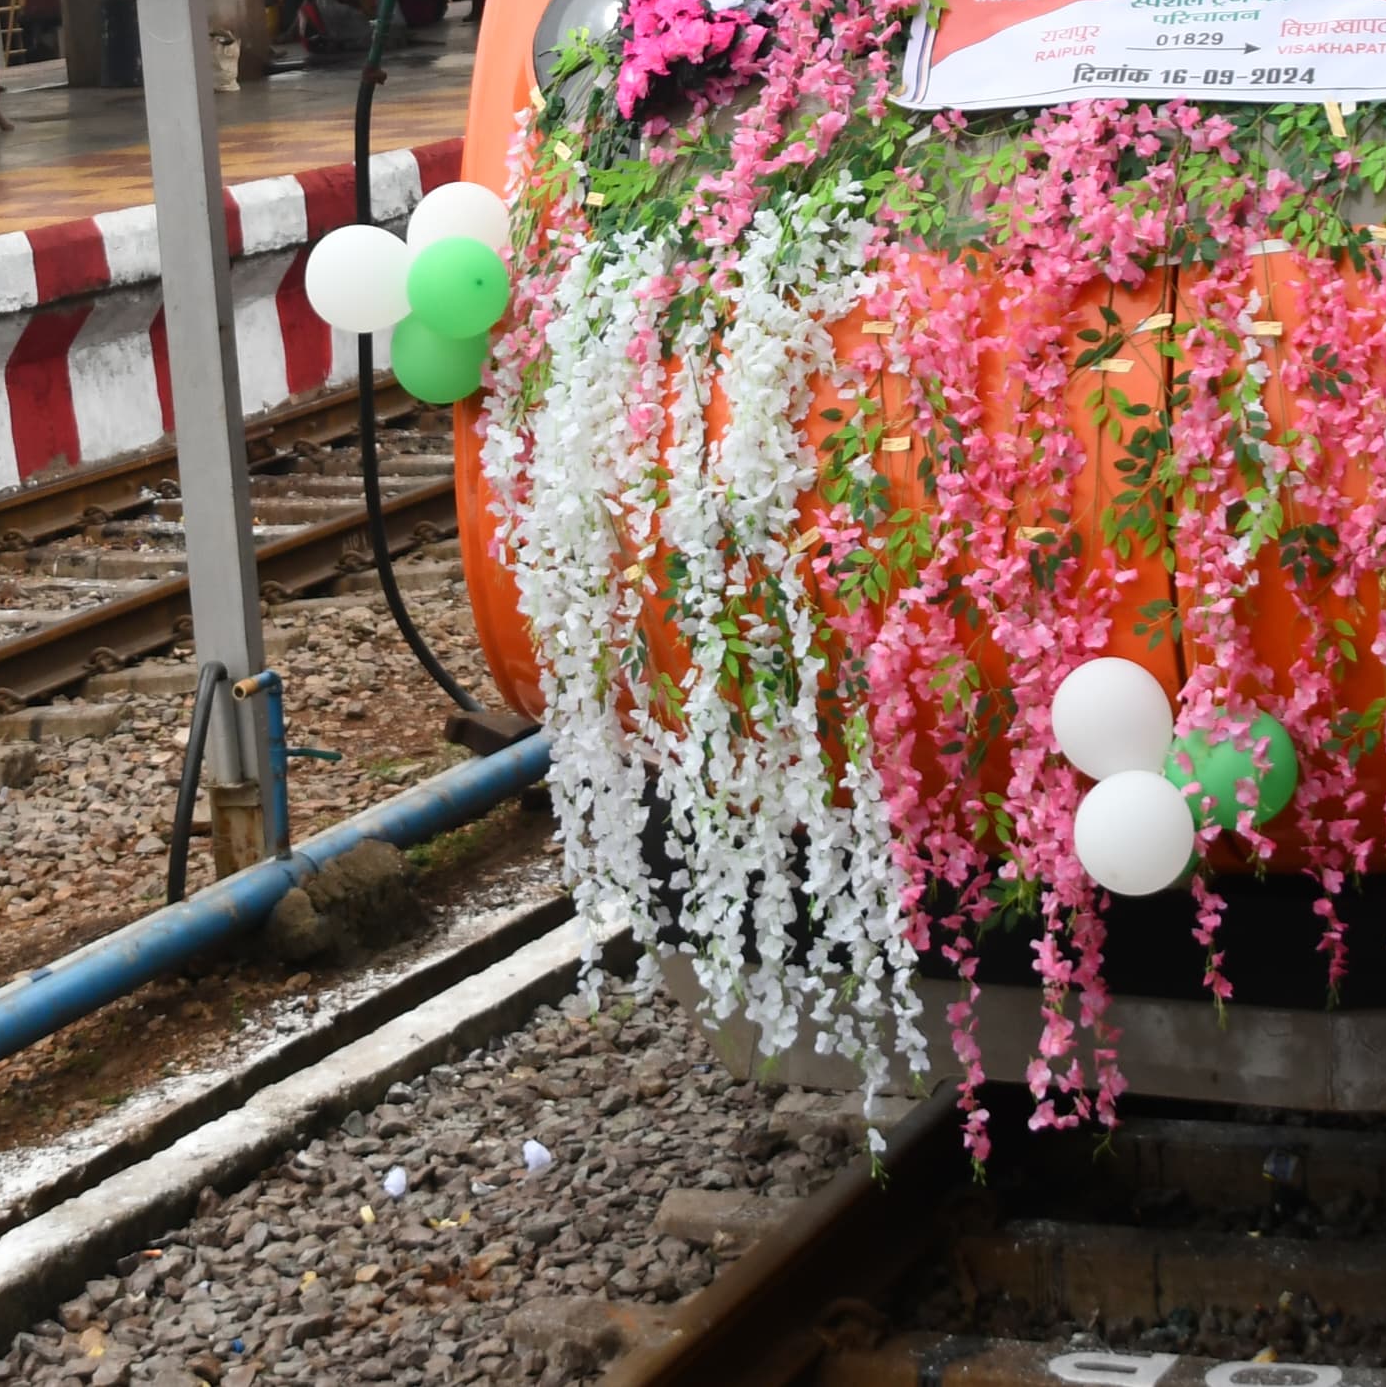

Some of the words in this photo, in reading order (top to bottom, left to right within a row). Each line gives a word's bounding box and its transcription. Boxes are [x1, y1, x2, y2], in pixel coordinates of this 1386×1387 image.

[1153, 8, 1262, 26] परिचालन
[1156, 32, 1224, 47] 01829
[1034, 45, 1097, 63] RAIPUR
[1072, 61, 1153, 85] दिनांक
[1160, 67, 1316, 86] 16-09-2024
